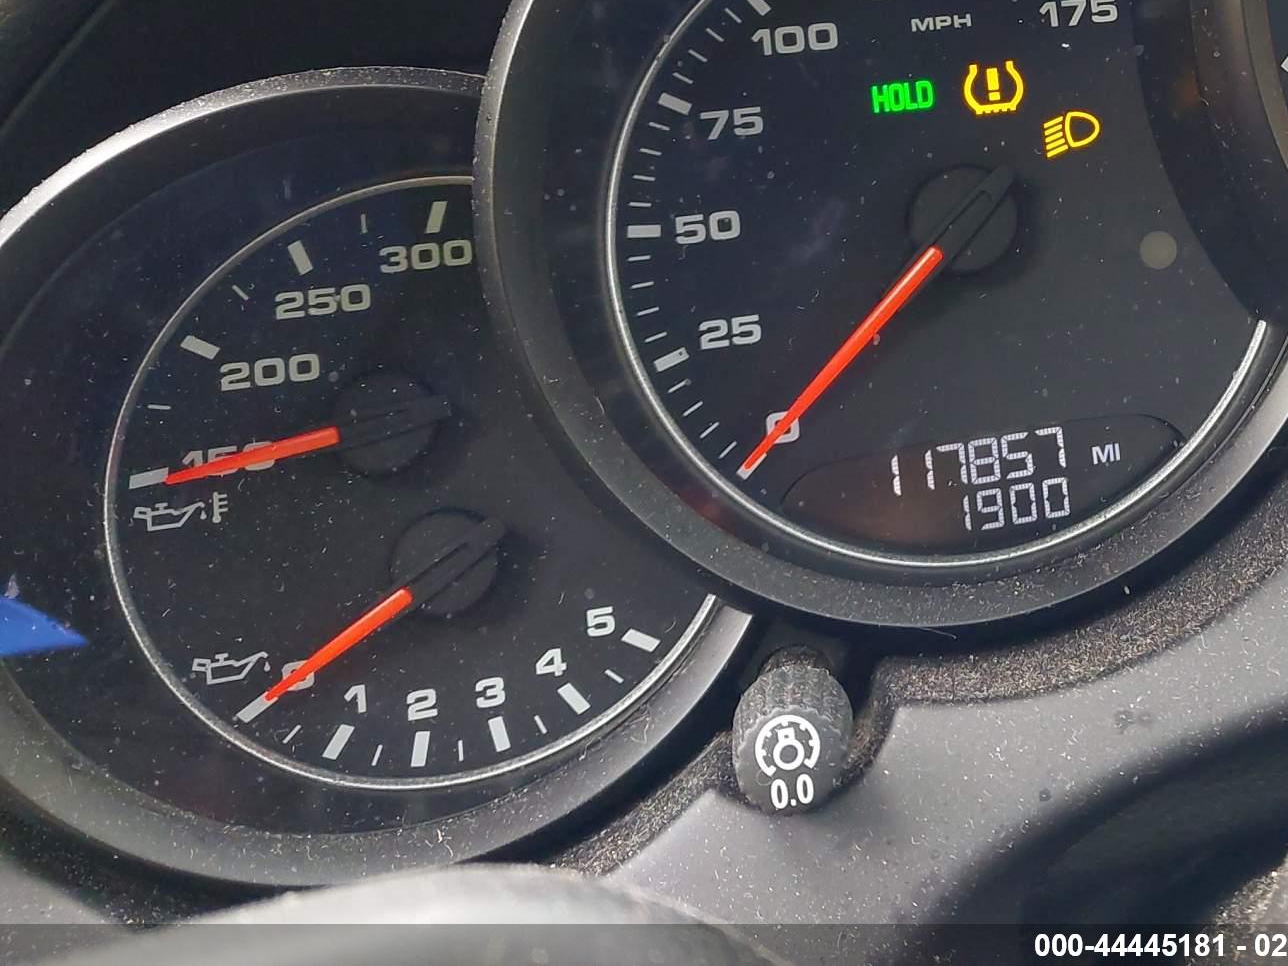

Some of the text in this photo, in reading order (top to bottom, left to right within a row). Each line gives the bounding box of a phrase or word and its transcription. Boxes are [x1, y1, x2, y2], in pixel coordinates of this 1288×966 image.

[752, 23, 839, 55] 100
[910, 13, 972, 33] MPH
[872, 80, 934, 114] HOLD
[700, 107, 764, 140] 75
[675, 211, 742, 245] 50
[378, 239, 473, 272] 300
[275, 284, 371, 320] 250
[699, 313, 762, 348] 25
[219, 354, 321, 391] 200
[766, 411, 800, 444] 0
[891, 425, 1121, 496] 117857 MI
[962, 476, 1070, 531] 1900
[586, 607, 616, 637] 5
[535, 648, 567, 676] 4
[344, 685, 367, 712] 1
[406, 689, 438, 719] 2
[475, 677, 507, 706] 3
[770, 774, 814, 809] 0.0
